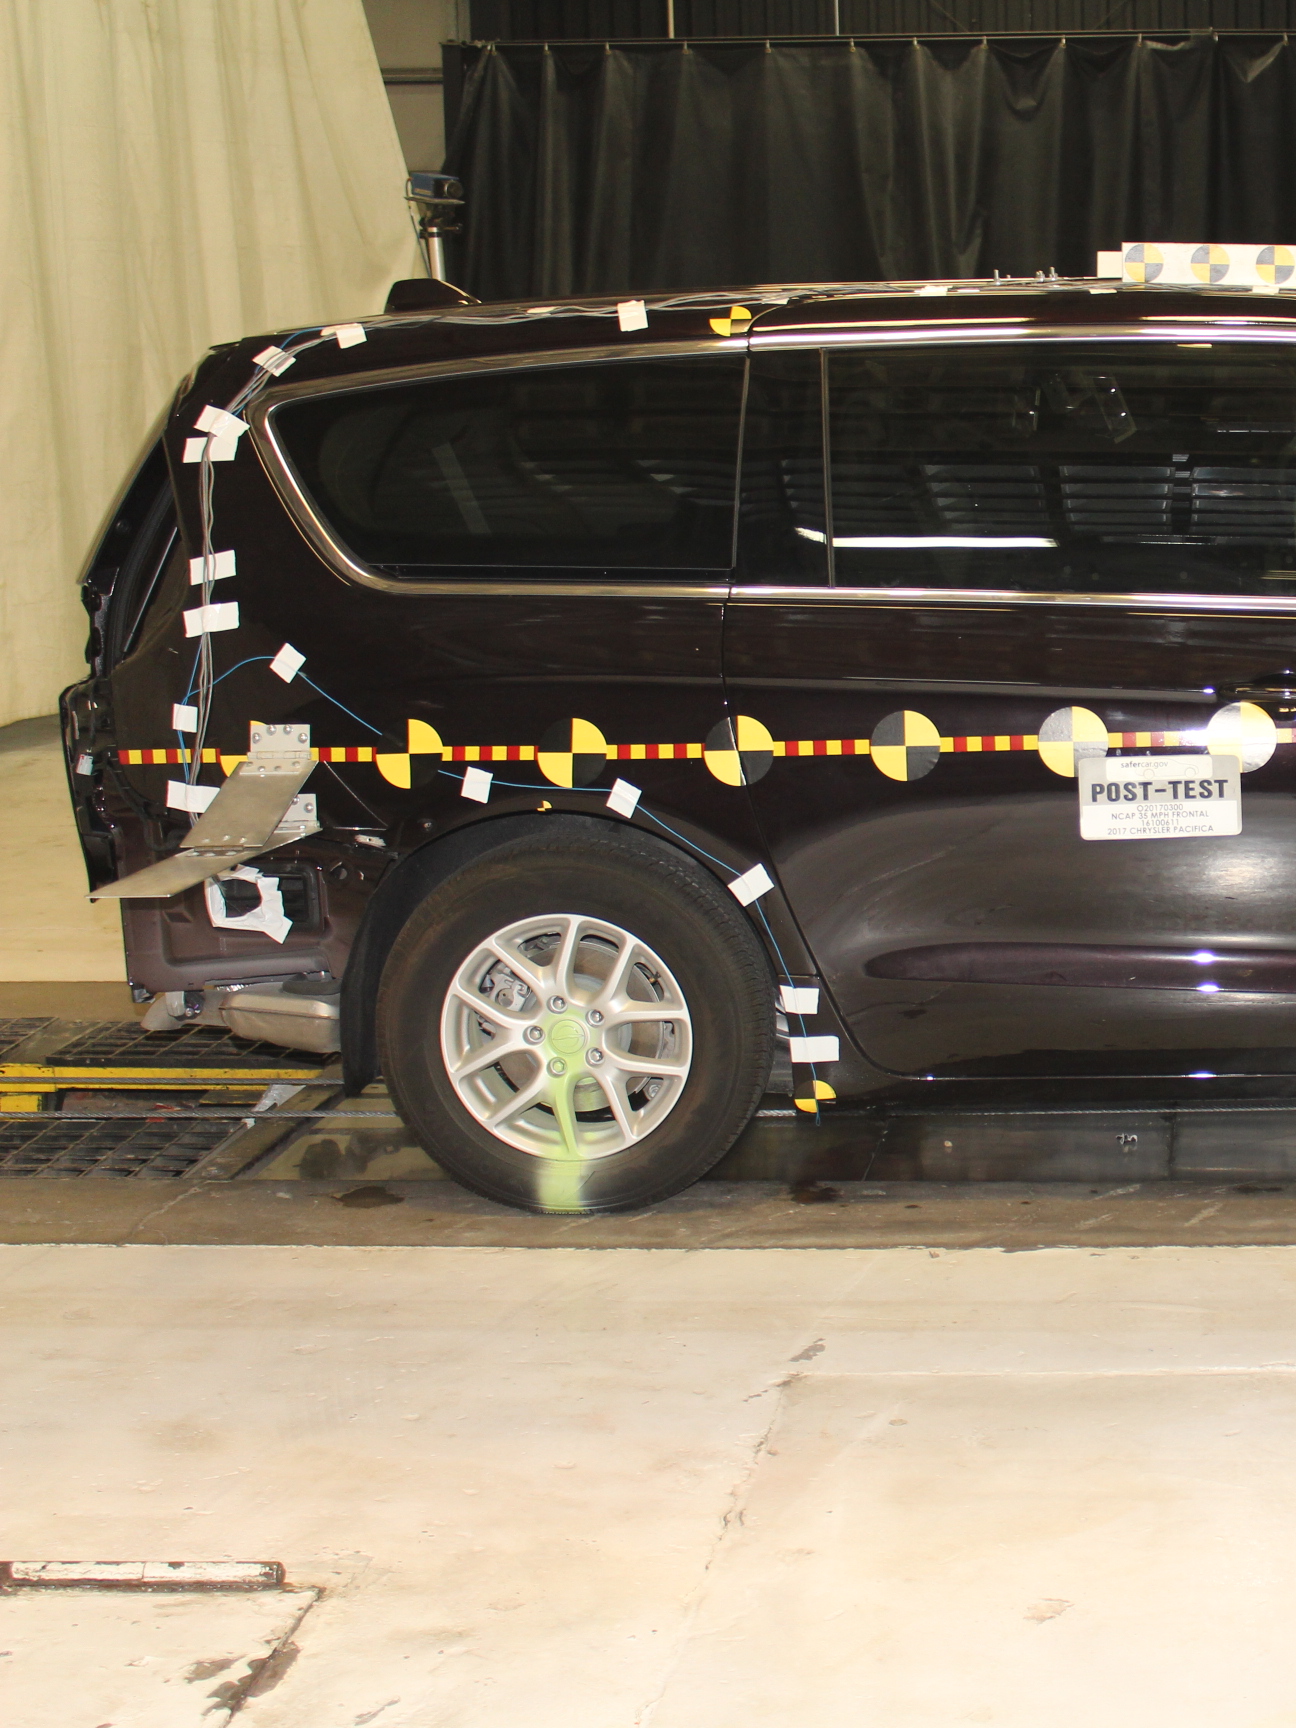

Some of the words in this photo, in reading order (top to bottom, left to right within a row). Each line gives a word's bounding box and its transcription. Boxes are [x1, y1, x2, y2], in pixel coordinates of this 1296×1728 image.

[1121, 761, 1168, 771] safercar.gov
[1091, 779, 1228, 803] POST-TEST
[1111, 812, 1136, 821] NCAP
[1138, 812, 1149, 820] 35
[1150, 811, 1170, 819] MPH
[1172, 810, 1209, 818] FRONTAL
[1141, 818, 1180, 827] 16100611
[1107, 827, 1127, 836] 2017
[1129, 826, 1171, 835] CHRYSLER
[1173, 824, 1214, 833] PACIFICA
